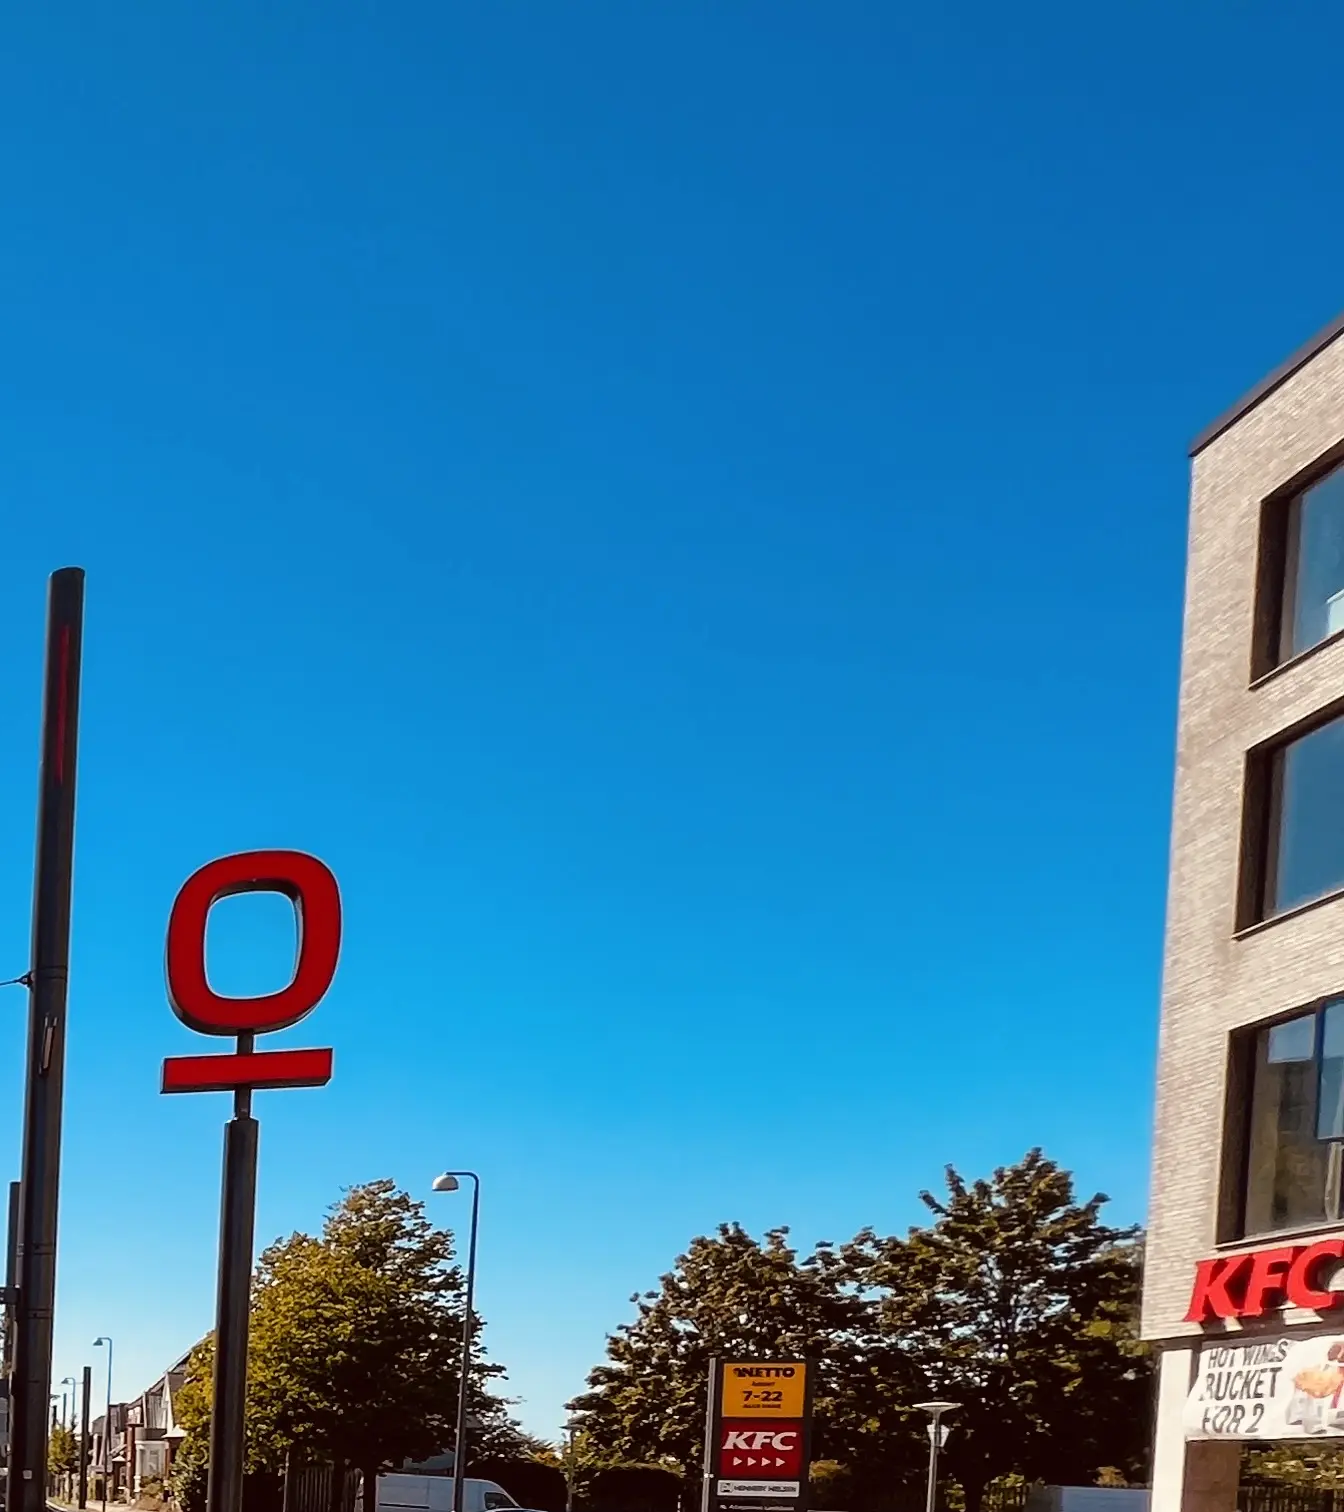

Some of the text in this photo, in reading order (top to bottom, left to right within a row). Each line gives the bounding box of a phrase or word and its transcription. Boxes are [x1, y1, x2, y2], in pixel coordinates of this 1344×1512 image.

[1182, 1239, 1344, 1322] KFC
[739, 1366, 795, 1378] NETTO
[742, 1390, 783, 1402] 7-22
[1244, 1402, 1265, 1434] 2
[722, 1431, 797, 1451] KFC
